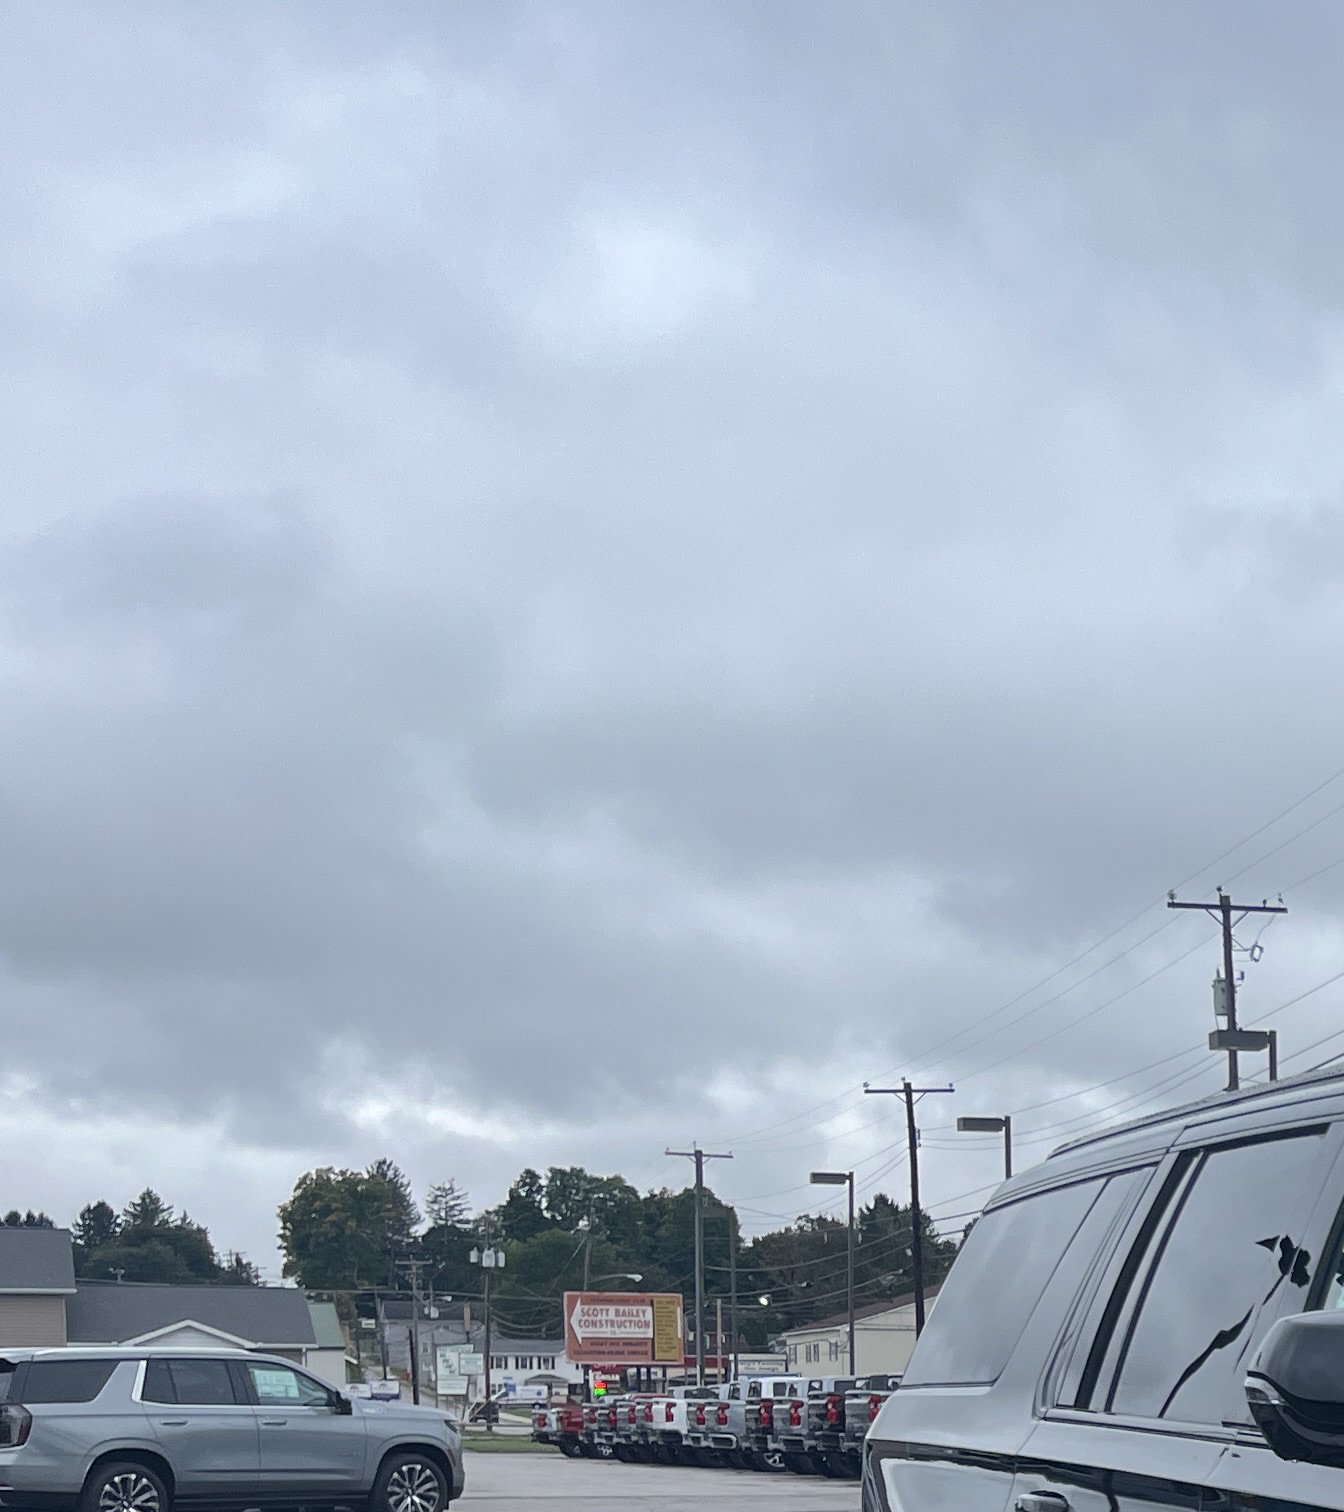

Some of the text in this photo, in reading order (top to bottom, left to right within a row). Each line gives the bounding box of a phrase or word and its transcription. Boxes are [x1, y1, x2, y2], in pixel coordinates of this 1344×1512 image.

[580, 1307, 647, 1318] SCOTT BAILEY
[578, 1318, 651, 1330] CONSTRUCTION
